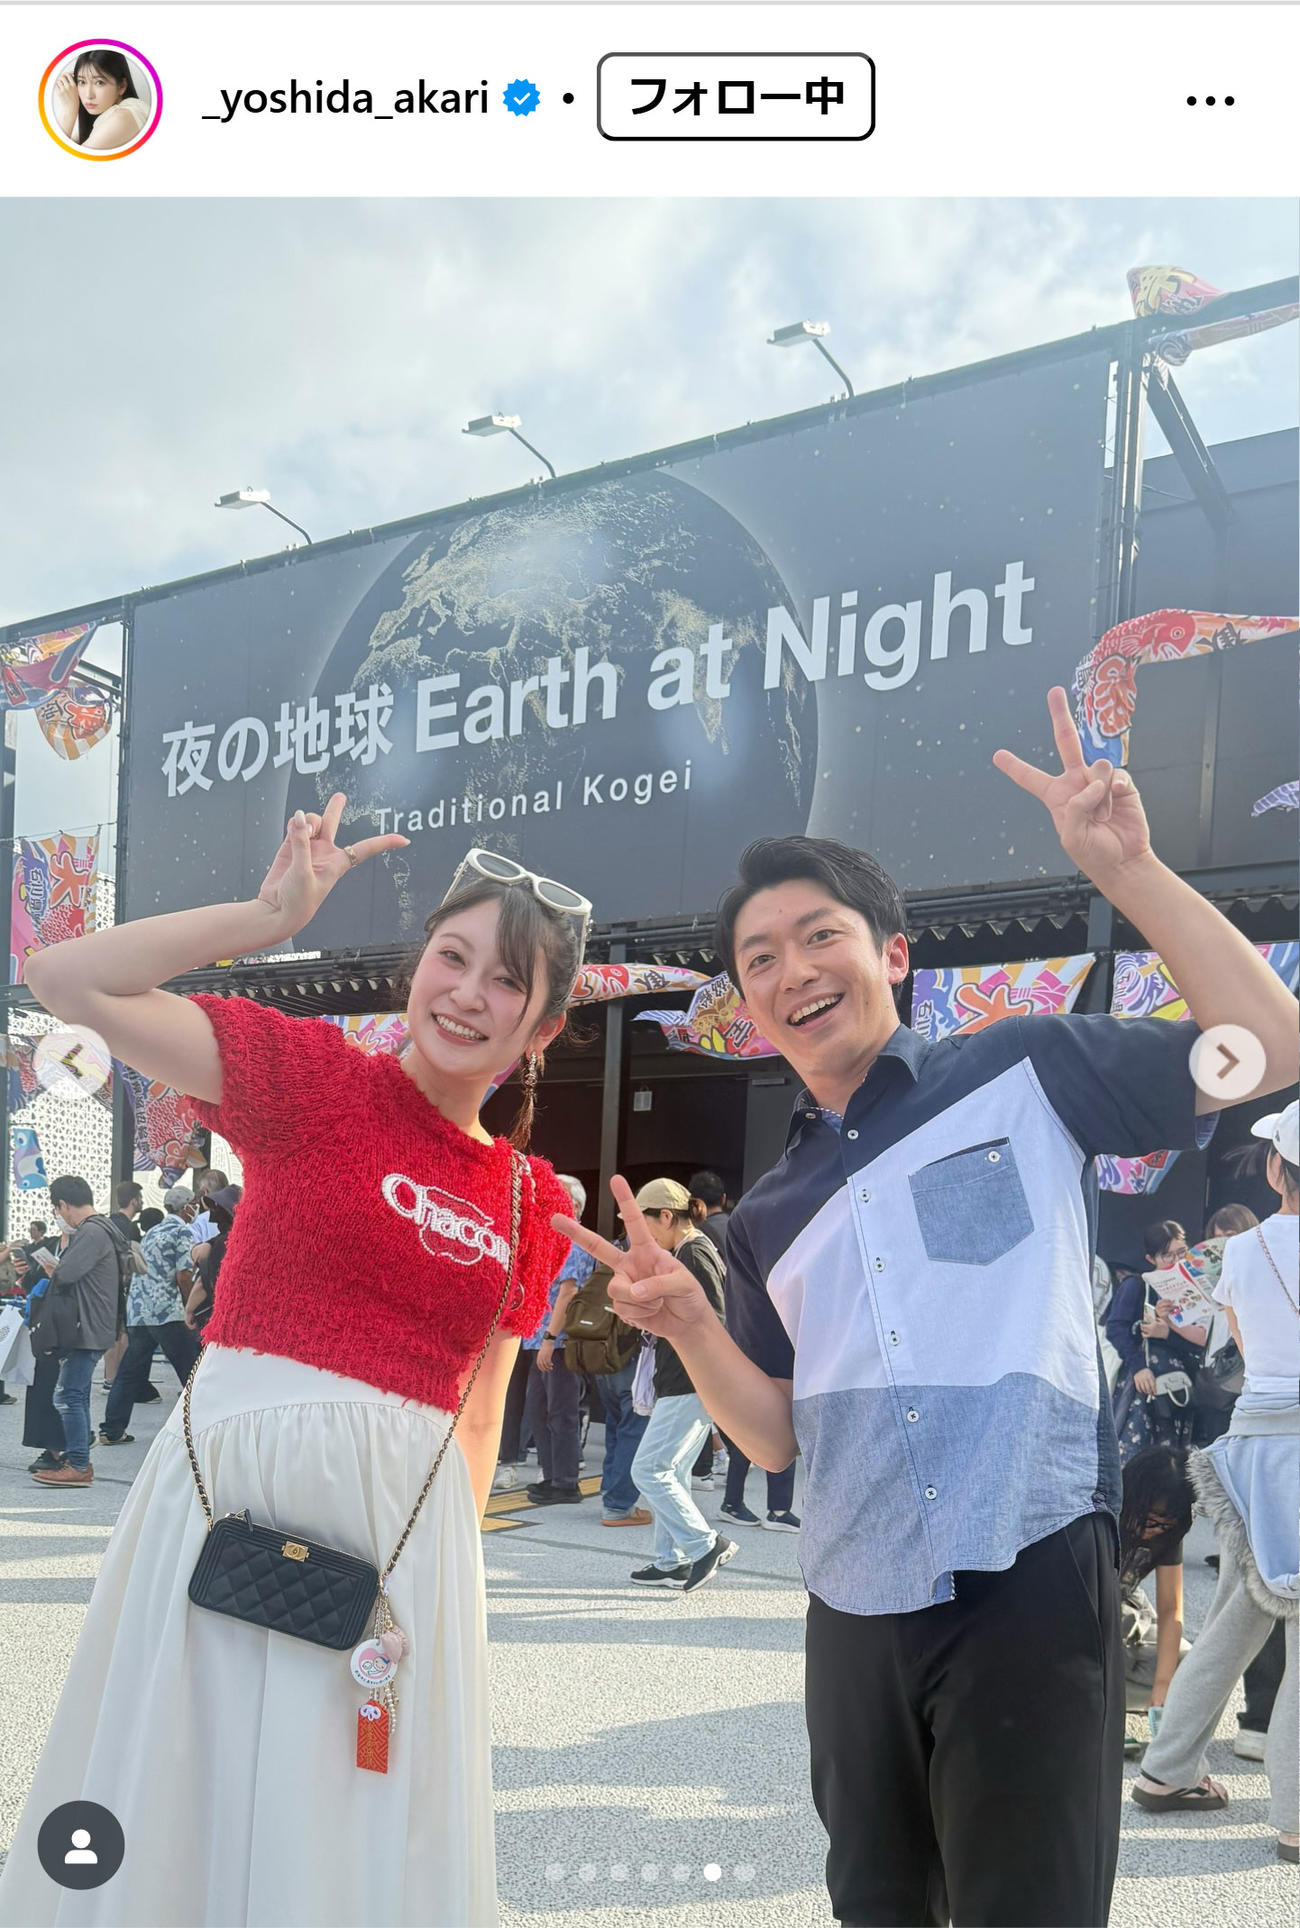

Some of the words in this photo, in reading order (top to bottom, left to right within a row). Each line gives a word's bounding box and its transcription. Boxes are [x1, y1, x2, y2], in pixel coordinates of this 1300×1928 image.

[161, 682, 394, 797] 夜の地球
[415, 646, 618, 753] Earth
[647, 622, 733, 711] at
[763, 560, 1035, 691] Night
[374, 780, 563, 835] Traditional
[583, 759, 692, 806] Kogei
